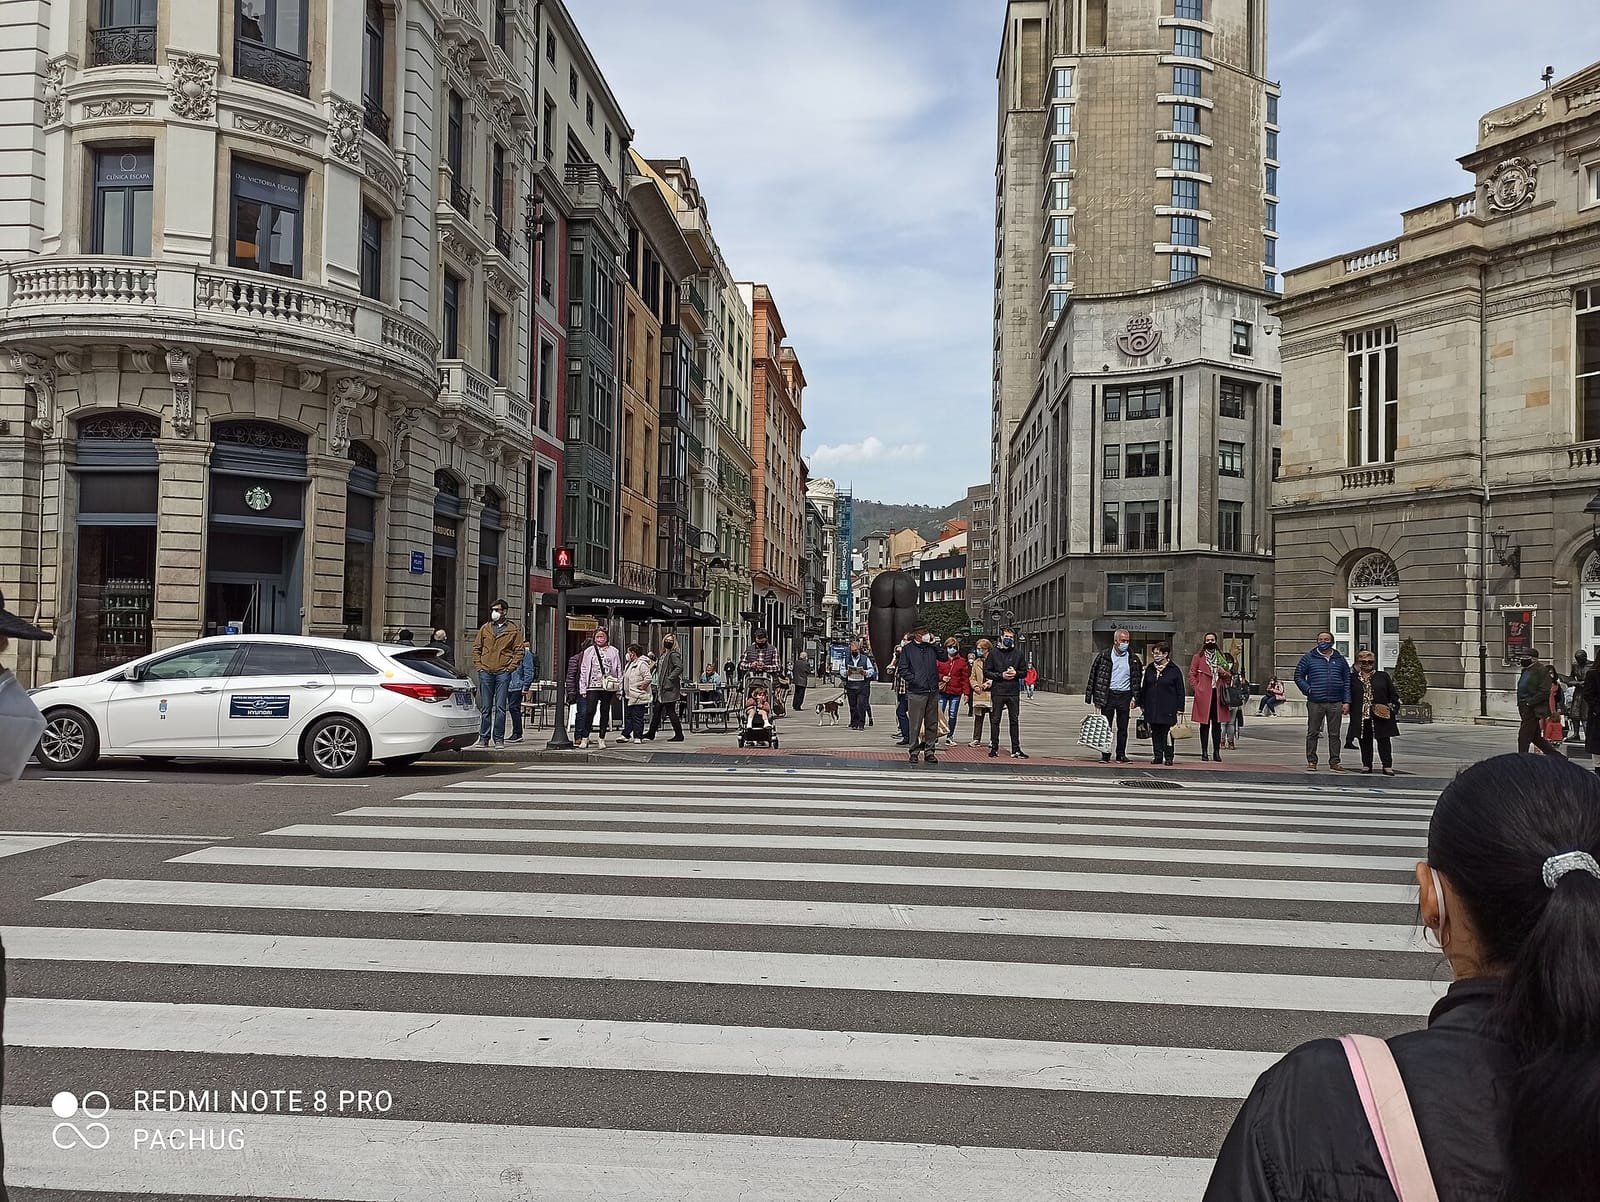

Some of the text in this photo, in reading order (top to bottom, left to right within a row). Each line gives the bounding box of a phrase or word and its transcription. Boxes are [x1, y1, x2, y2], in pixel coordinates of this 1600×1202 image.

[248, 176, 276, 188] VICTORIA
[277, 183, 299, 193] ESCAPA
[434, 525, 455, 538] ARBUCKS
[591, 597, 624, 605] STARBUCKS
